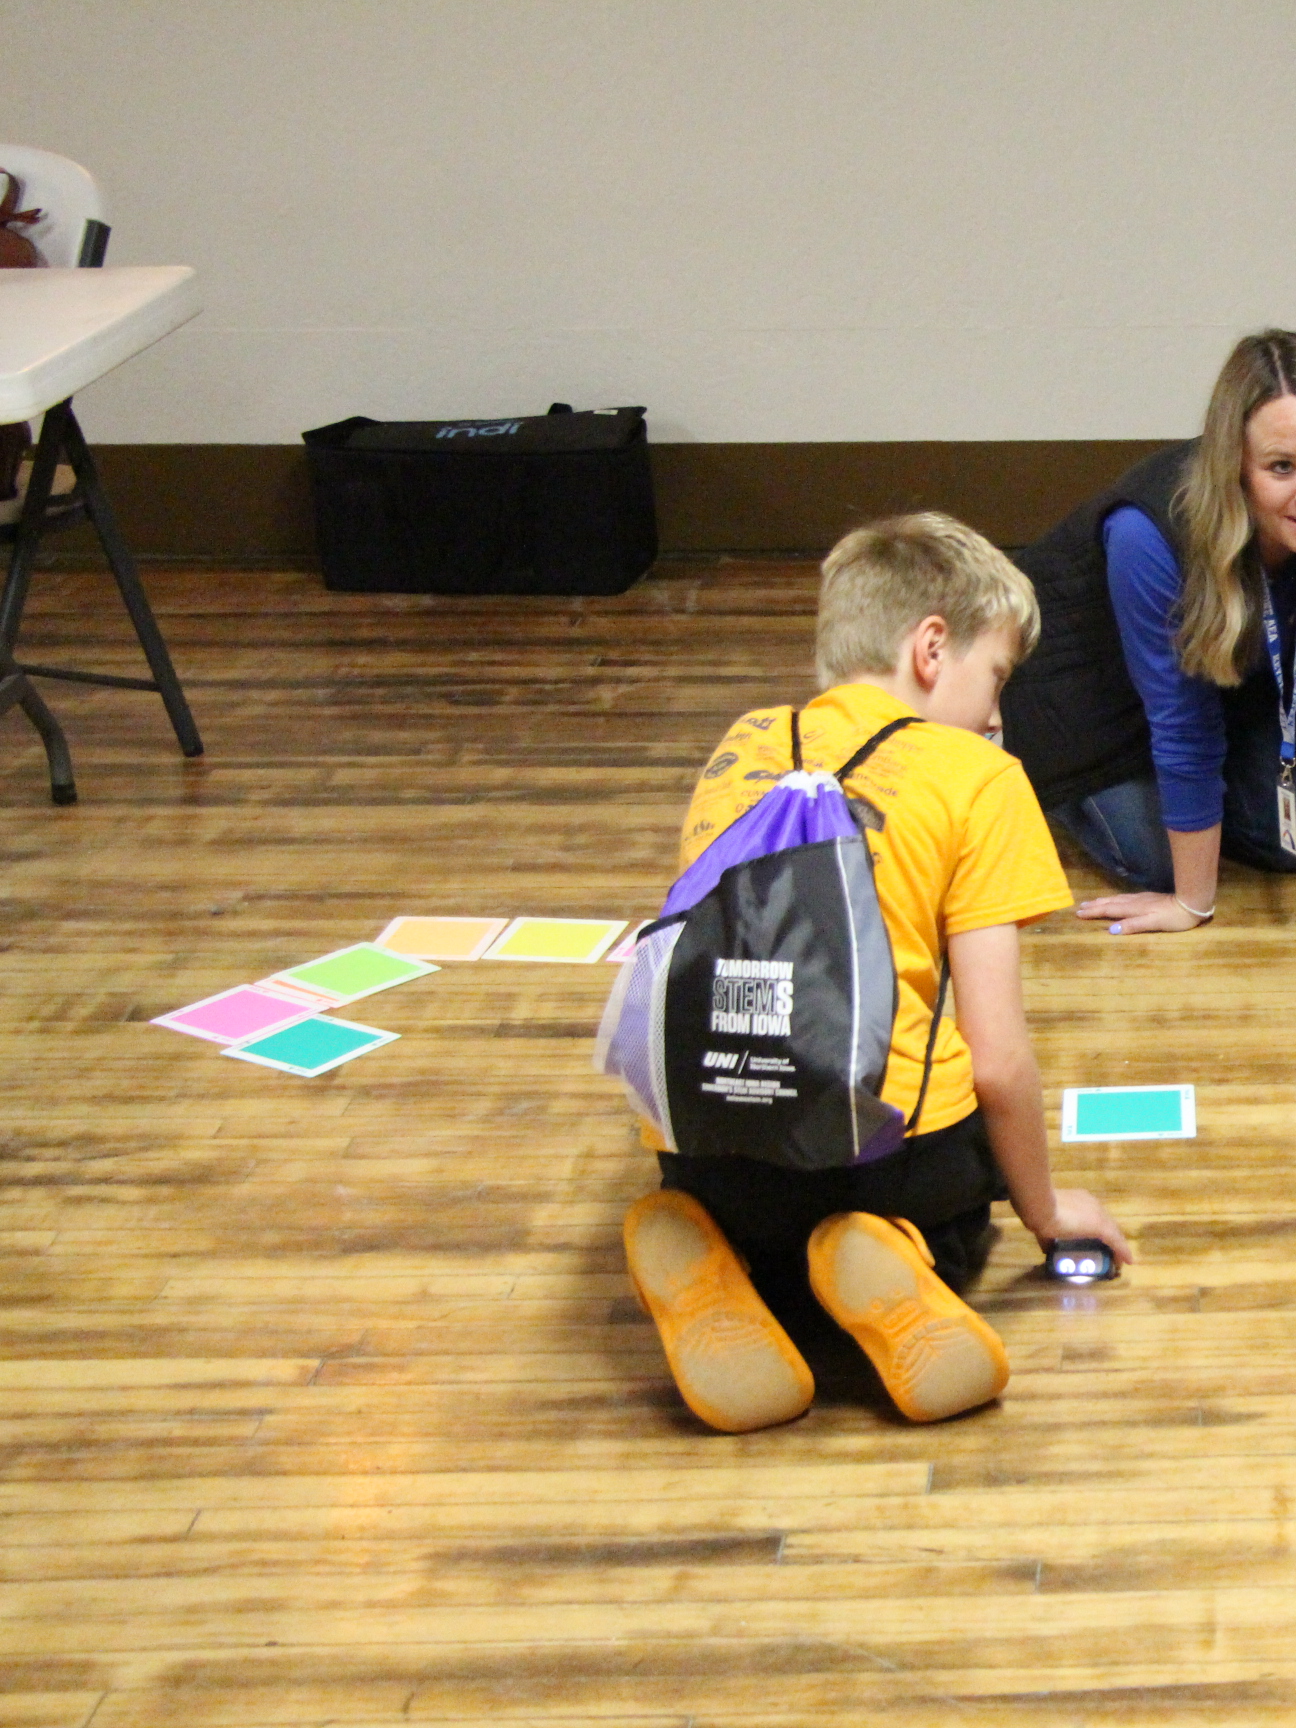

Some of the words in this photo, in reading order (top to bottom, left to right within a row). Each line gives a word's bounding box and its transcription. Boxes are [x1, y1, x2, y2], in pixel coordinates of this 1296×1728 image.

[435, 422, 524, 439] indi
[713, 977, 794, 1015] STEMS
[711, 1011, 750, 1034] FROM
[752, 1014, 791, 1037] IOWA
[703, 1051, 739, 1069] UNI
